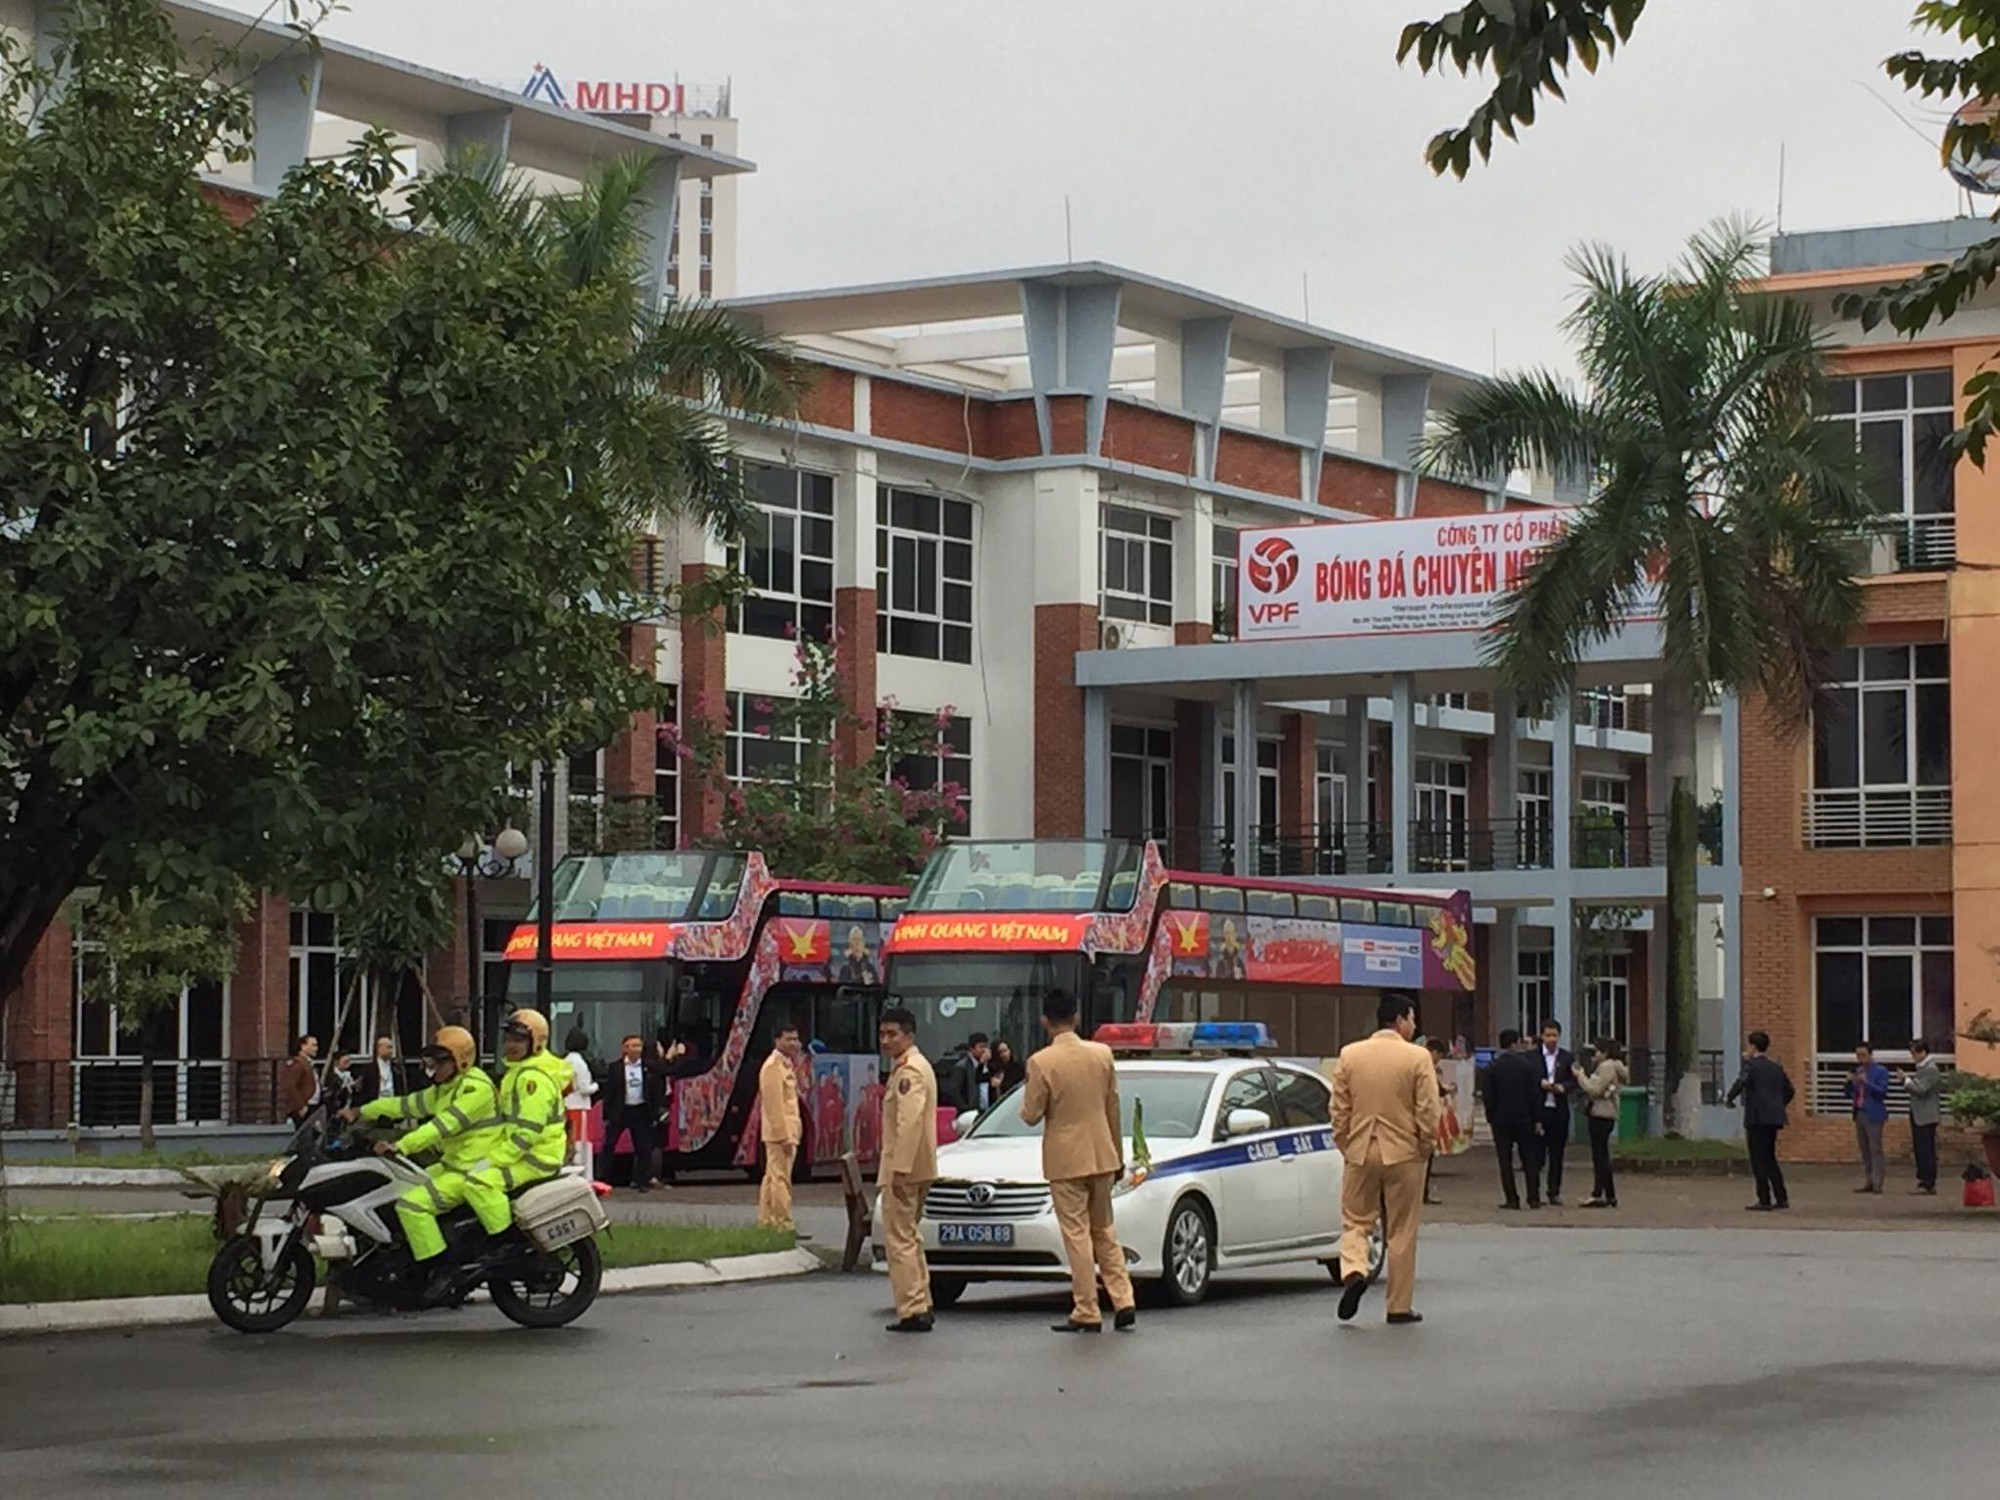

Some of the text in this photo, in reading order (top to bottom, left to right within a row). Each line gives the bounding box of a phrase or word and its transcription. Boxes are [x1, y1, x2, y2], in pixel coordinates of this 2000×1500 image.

[577, 81, 684, 114] MHDI
[1482, 523, 1499, 544] TY
[1316, 554, 1371, 602] BÓNG
[1378, 550, 1406, 599] ĐÁ
[1413, 545, 1497, 598] CHUYÊN
[1248, 602, 1299, 624] VPF
[930, 922, 987, 939] QUANG
[1026, 924, 1069, 943] NAM
